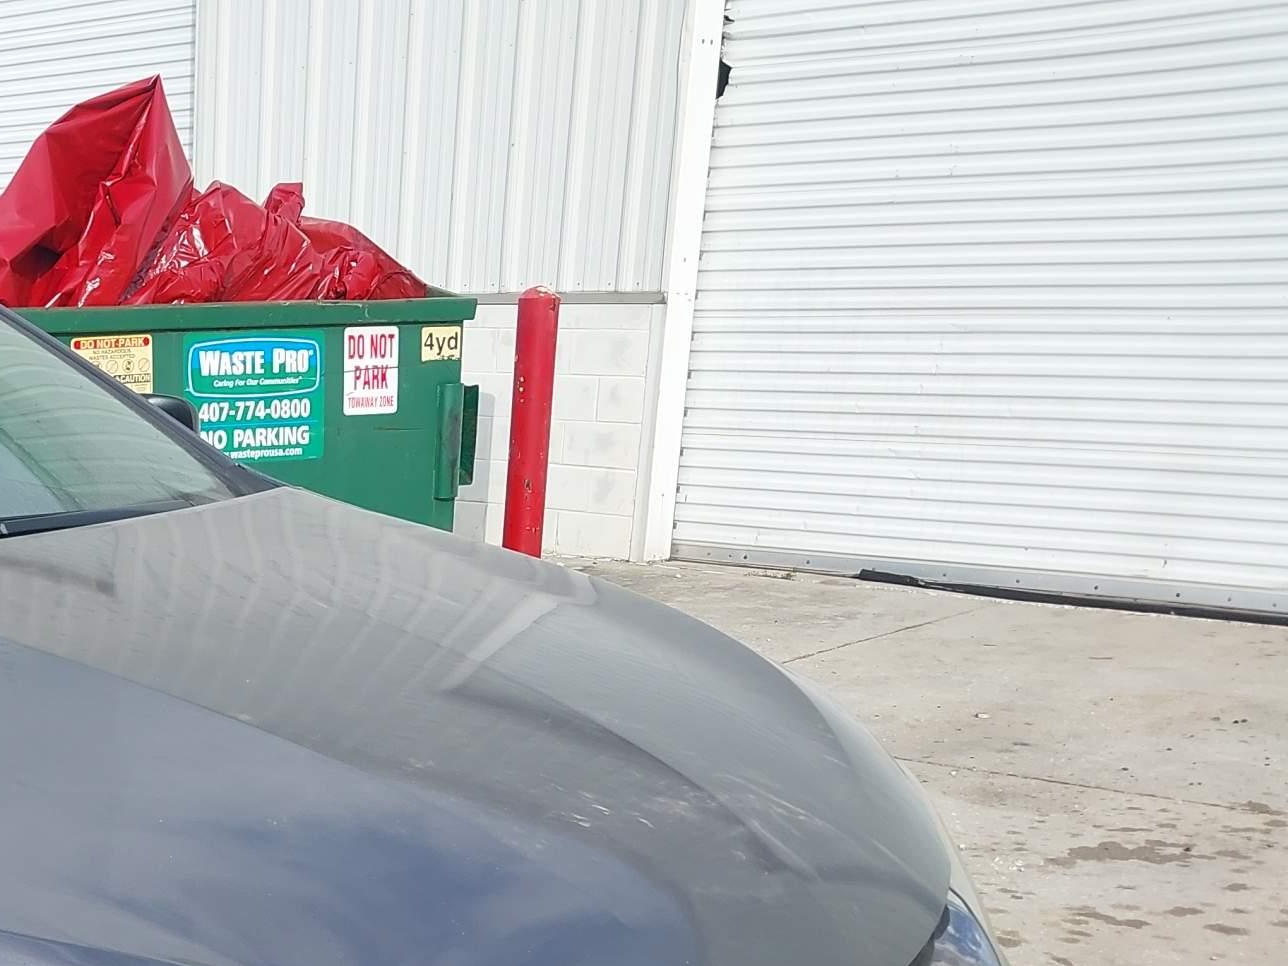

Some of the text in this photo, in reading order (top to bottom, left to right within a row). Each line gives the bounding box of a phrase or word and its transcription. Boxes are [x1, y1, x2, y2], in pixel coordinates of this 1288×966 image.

[81, 337, 144, 350] DO NOT PARK
[348, 334, 395, 359] DO NOT
[423, 331, 459, 356] 4yd
[199, 348, 310, 376] WASTE PRO
[121, 374, 151, 383] CAUTION
[213, 379, 234, 388] Caring
[246, 378, 259, 386] Our
[353, 364, 389, 390] PARK
[199, 398, 311, 422] 407-774-0800
[348, 396, 394, 408] TOWAWAY ZONE
[200, 425, 310, 450] NO PARKING
